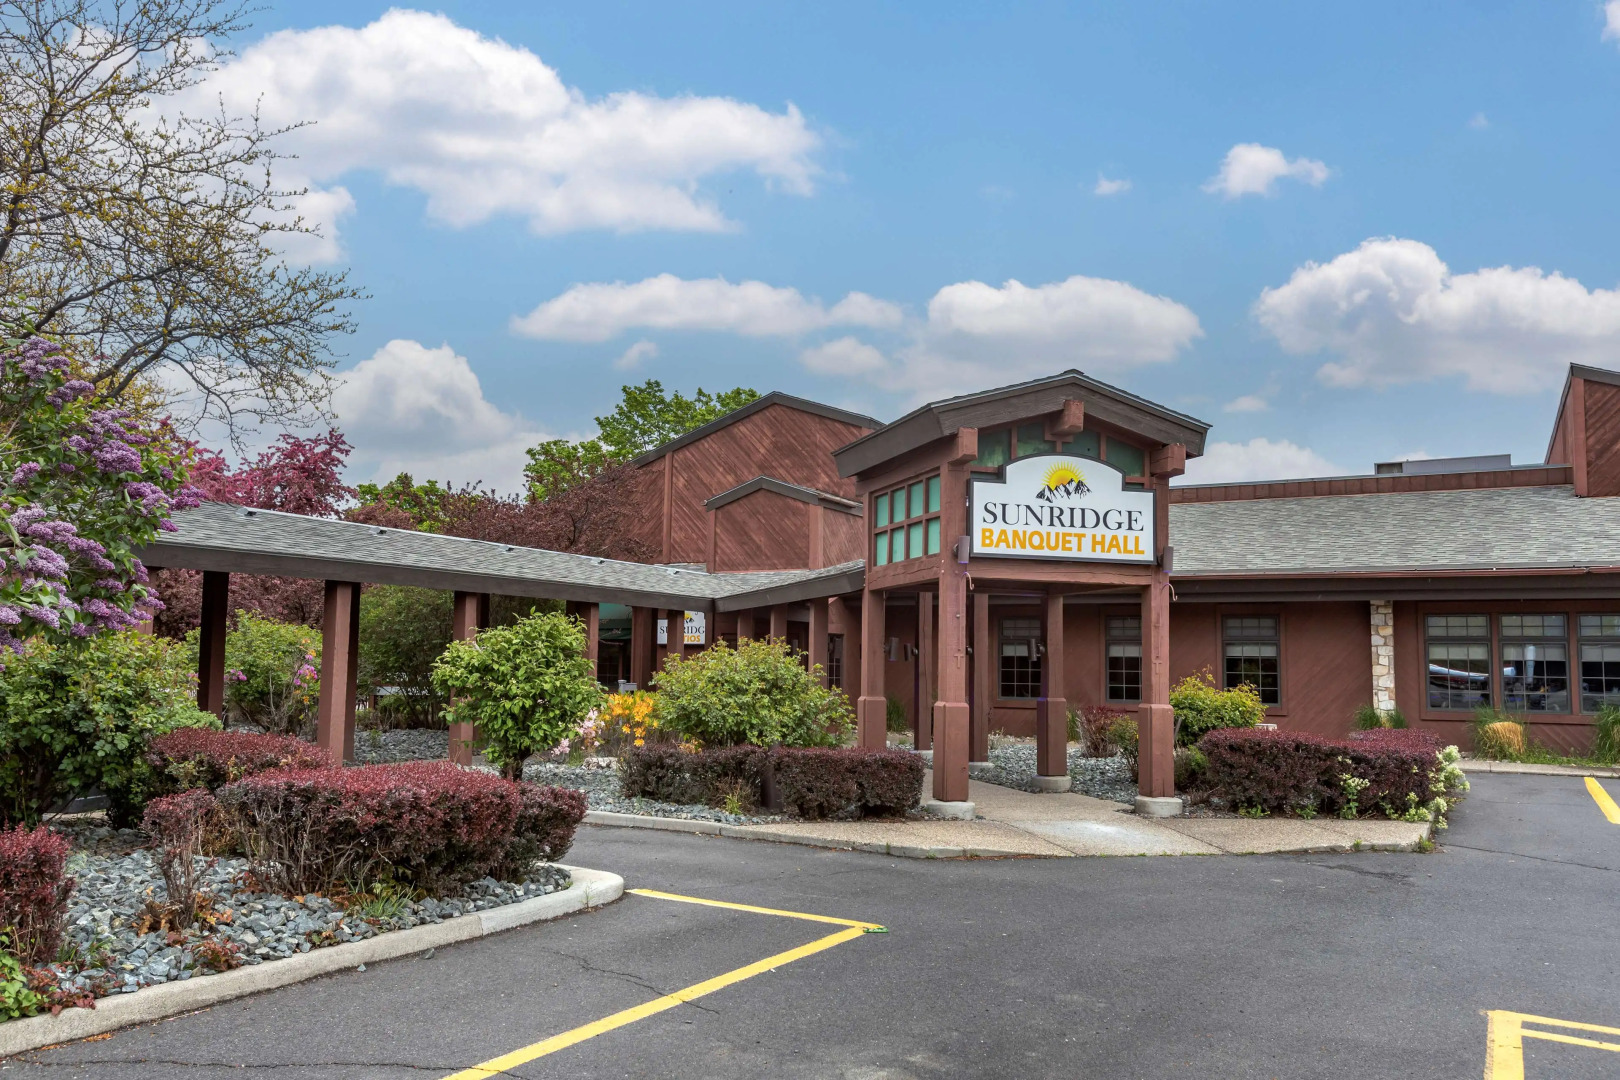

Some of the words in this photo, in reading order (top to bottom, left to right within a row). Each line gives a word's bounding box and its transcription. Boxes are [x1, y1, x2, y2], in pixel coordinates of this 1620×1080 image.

[983, 502, 1144, 532] SUNRIDGE
[981, 528, 1086, 553] BANQUET
[1091, 534, 1145, 555] HALL
[683, 634, 701, 643] TIOS
